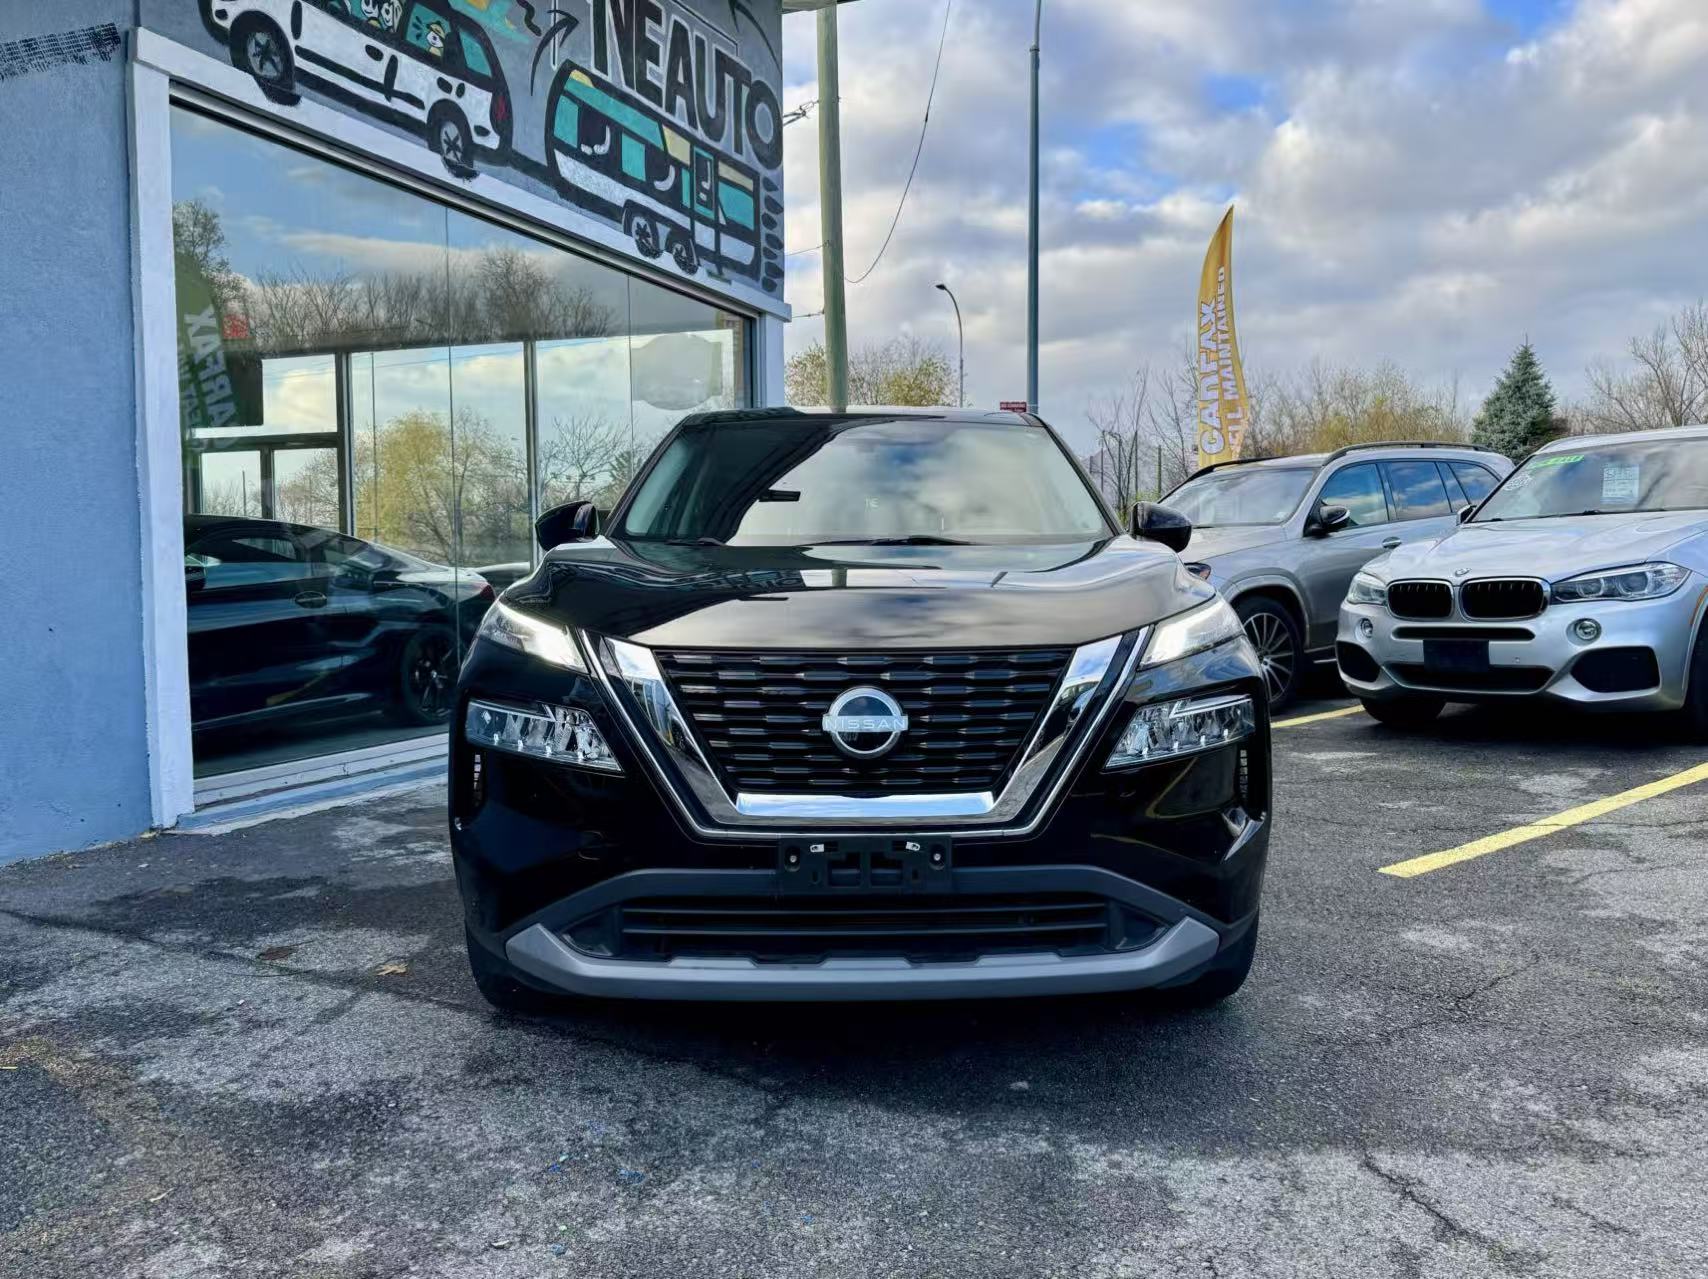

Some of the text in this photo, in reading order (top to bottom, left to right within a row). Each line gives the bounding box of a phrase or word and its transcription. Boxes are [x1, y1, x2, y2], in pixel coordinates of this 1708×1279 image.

[1200, 297, 1226, 456] CARFAX
[1216, 266, 1240, 400] MAINTAINED
[825, 718, 905, 730] NISSAN
